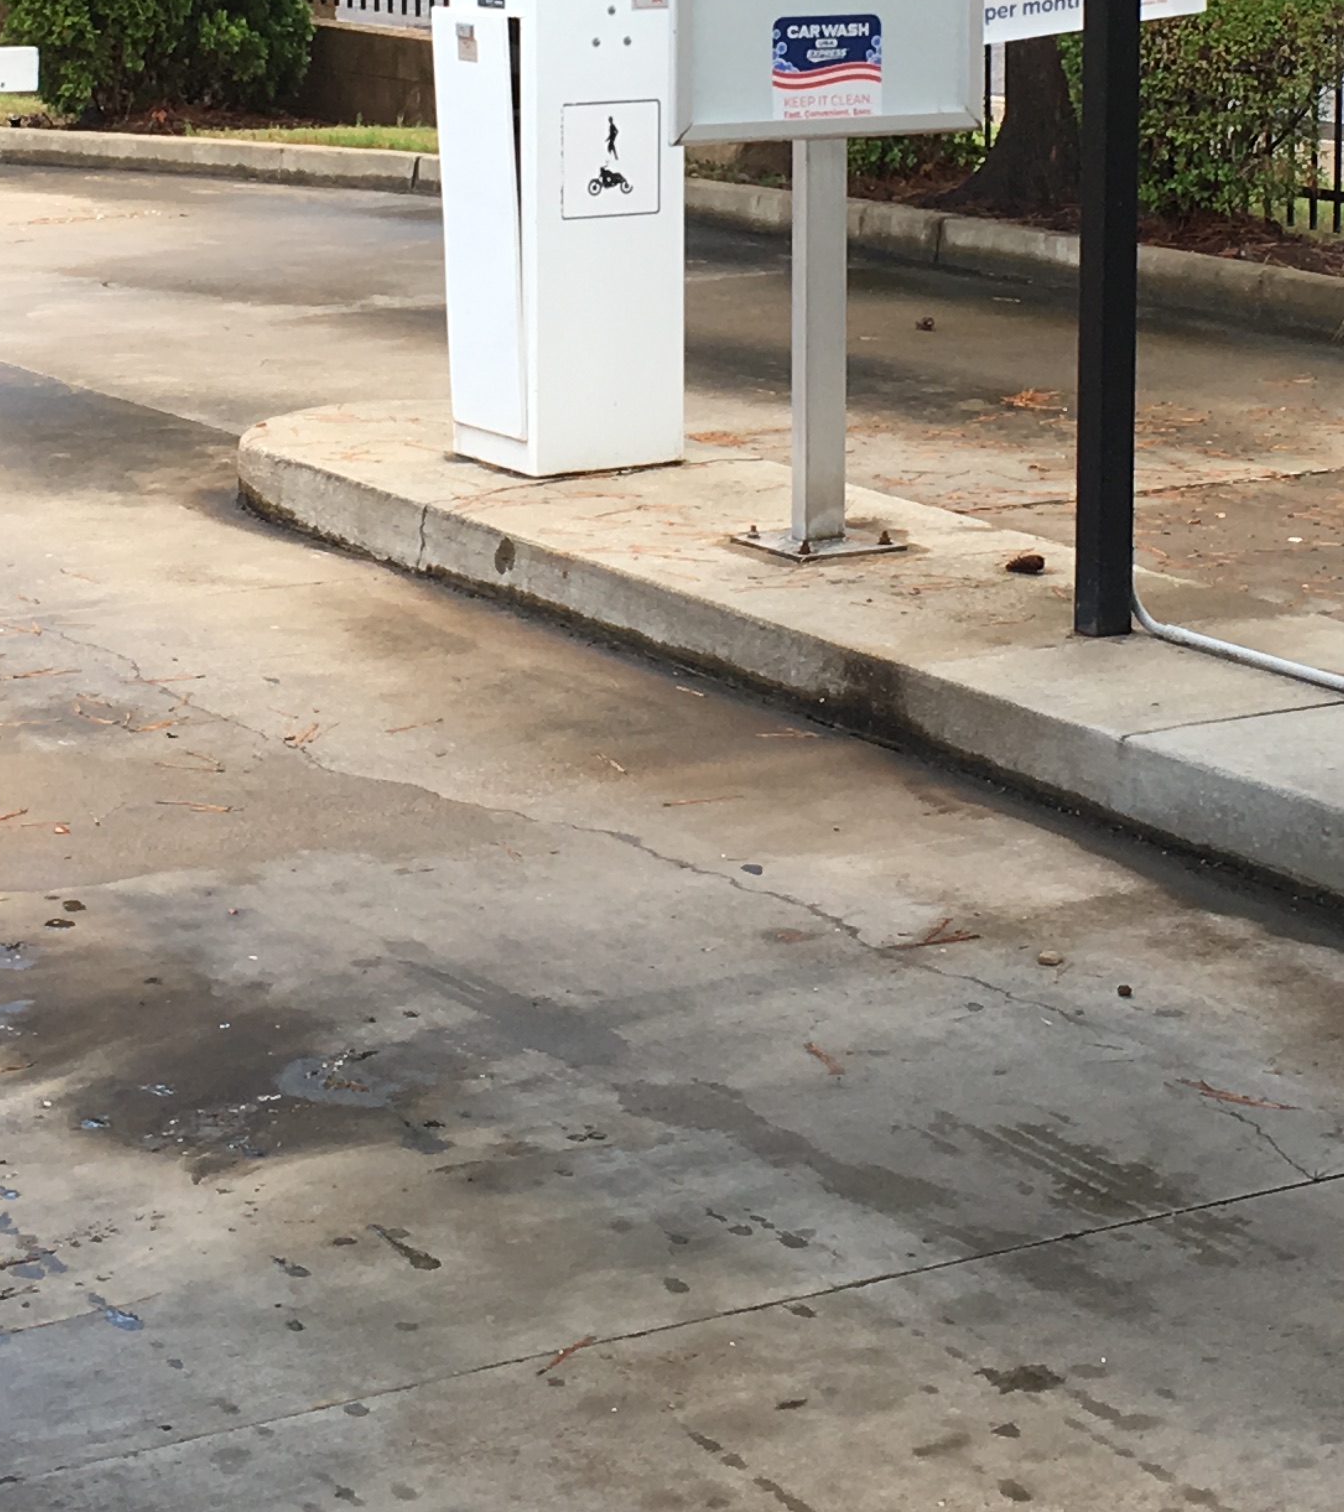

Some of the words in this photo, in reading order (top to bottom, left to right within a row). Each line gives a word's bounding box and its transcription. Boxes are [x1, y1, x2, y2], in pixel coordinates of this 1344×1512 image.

[984, 4, 1018, 26] per
[786, 24, 820, 39] CAR
[822, 22, 870, 37] WASH
[783, 95, 816, 108] KEEP
[818, 95, 828, 106] IT
[830, 94, 871, 105] CLEAN
